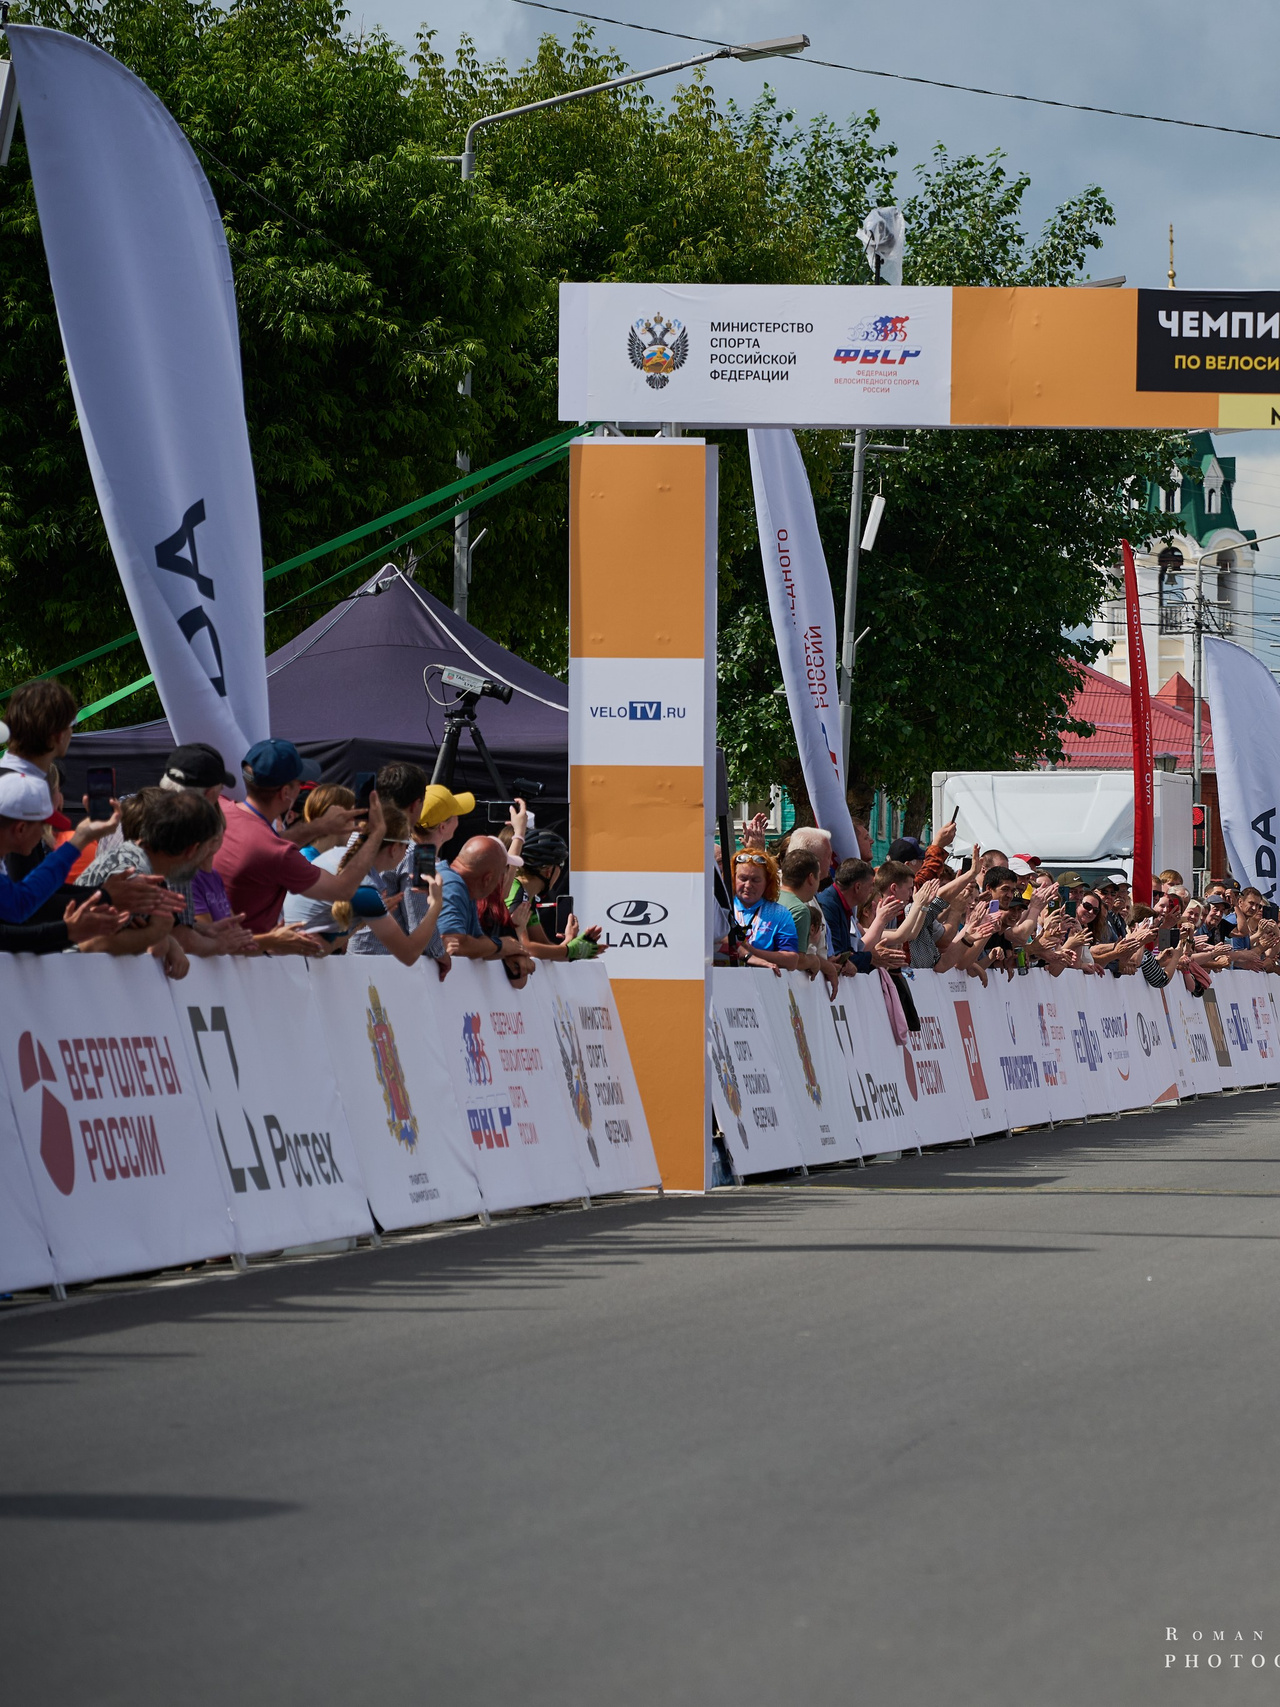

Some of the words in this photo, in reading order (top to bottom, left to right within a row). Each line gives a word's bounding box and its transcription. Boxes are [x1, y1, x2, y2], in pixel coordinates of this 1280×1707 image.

[709, 320, 814, 334] МИНИСТЕРСТВО
[709, 336, 761, 350] СПОРТА
[709, 350, 798, 366] РОССИЙСКОЙ
[1174, 355, 1201, 371] ПО
[709, 368, 790, 384] ФЕДЕРАЦИИ
[834, 377, 893, 387] ВЕЛОСИПЕДНОГО
[894, 379, 920, 387] СПОРТА
[856, 370, 898, 379] ФЕДЕРАЦИЯ
[809, 625, 829, 709] РОССИИ
[605, 931, 669, 948] LADA
[57, 1035, 183, 1102] ВЕРТОЛЕТЫ
[79, 1114, 166, 1183] РОССИИ
[263, 1114, 344, 1189] Ростех
